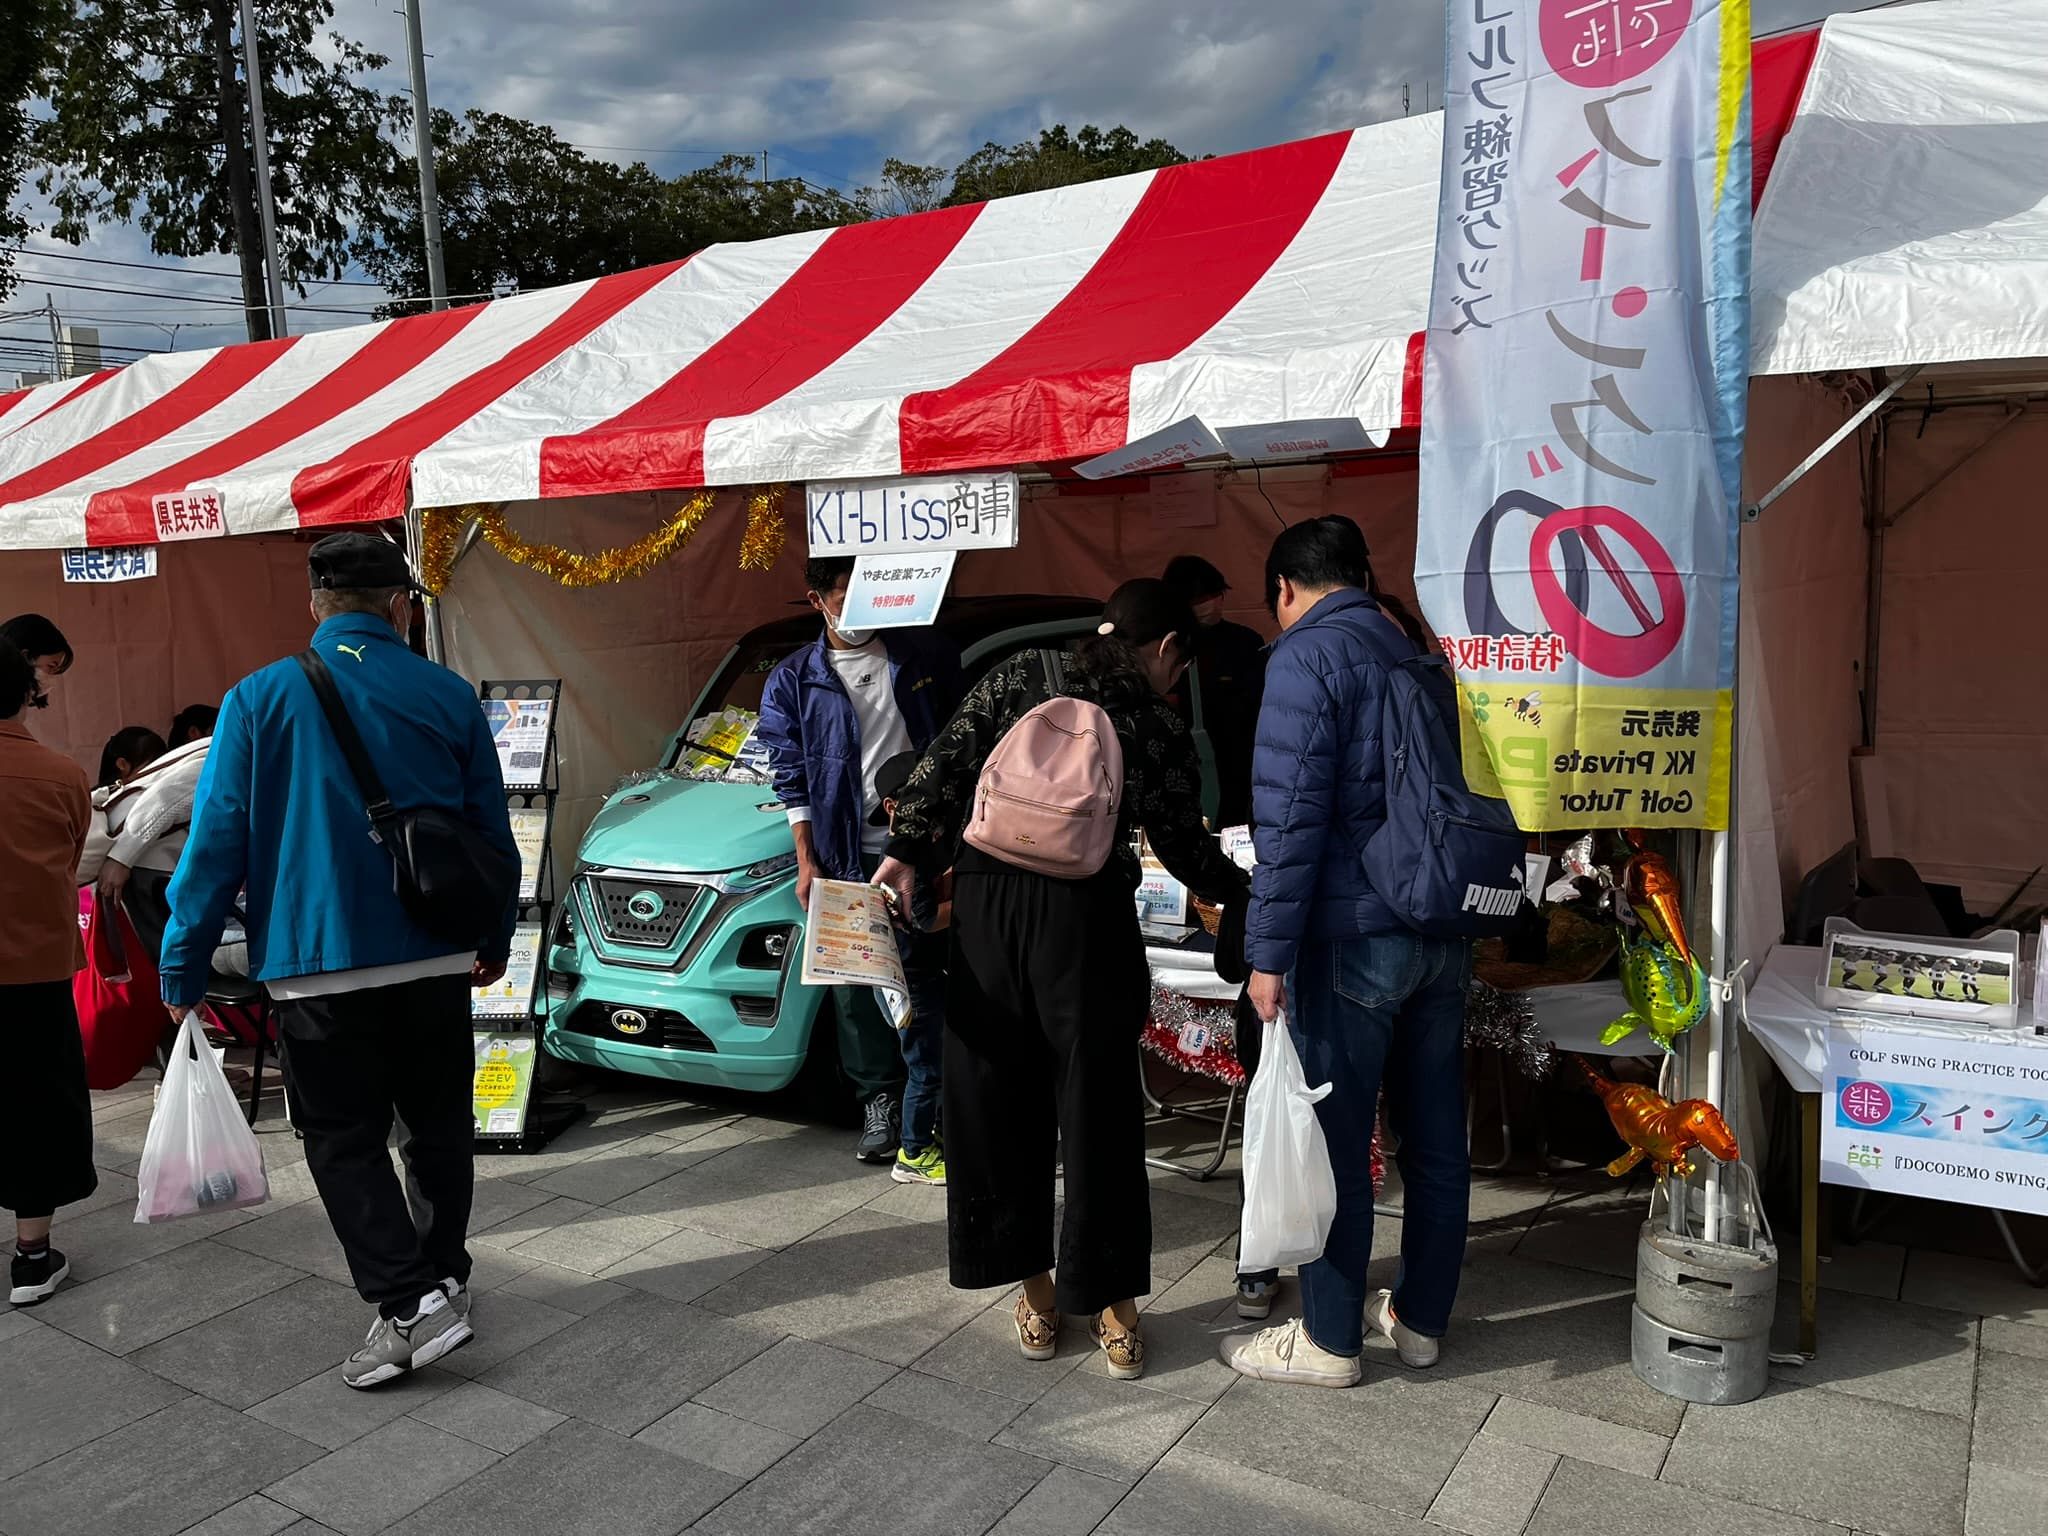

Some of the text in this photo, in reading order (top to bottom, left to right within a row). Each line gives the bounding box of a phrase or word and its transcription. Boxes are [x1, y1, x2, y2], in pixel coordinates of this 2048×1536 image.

[156, 494, 220, 535] 県民共済
[862, 567, 942, 581] やまと産業フェア
[871, 594, 916, 608] 特別価格
[1461, 883, 1521, 916] PUMA
[1849, 1049, 1887, 1063] GOLF
[1891, 1053, 1937, 1069] SWING
[1942, 1059, 2015, 1077] PRACTICE
